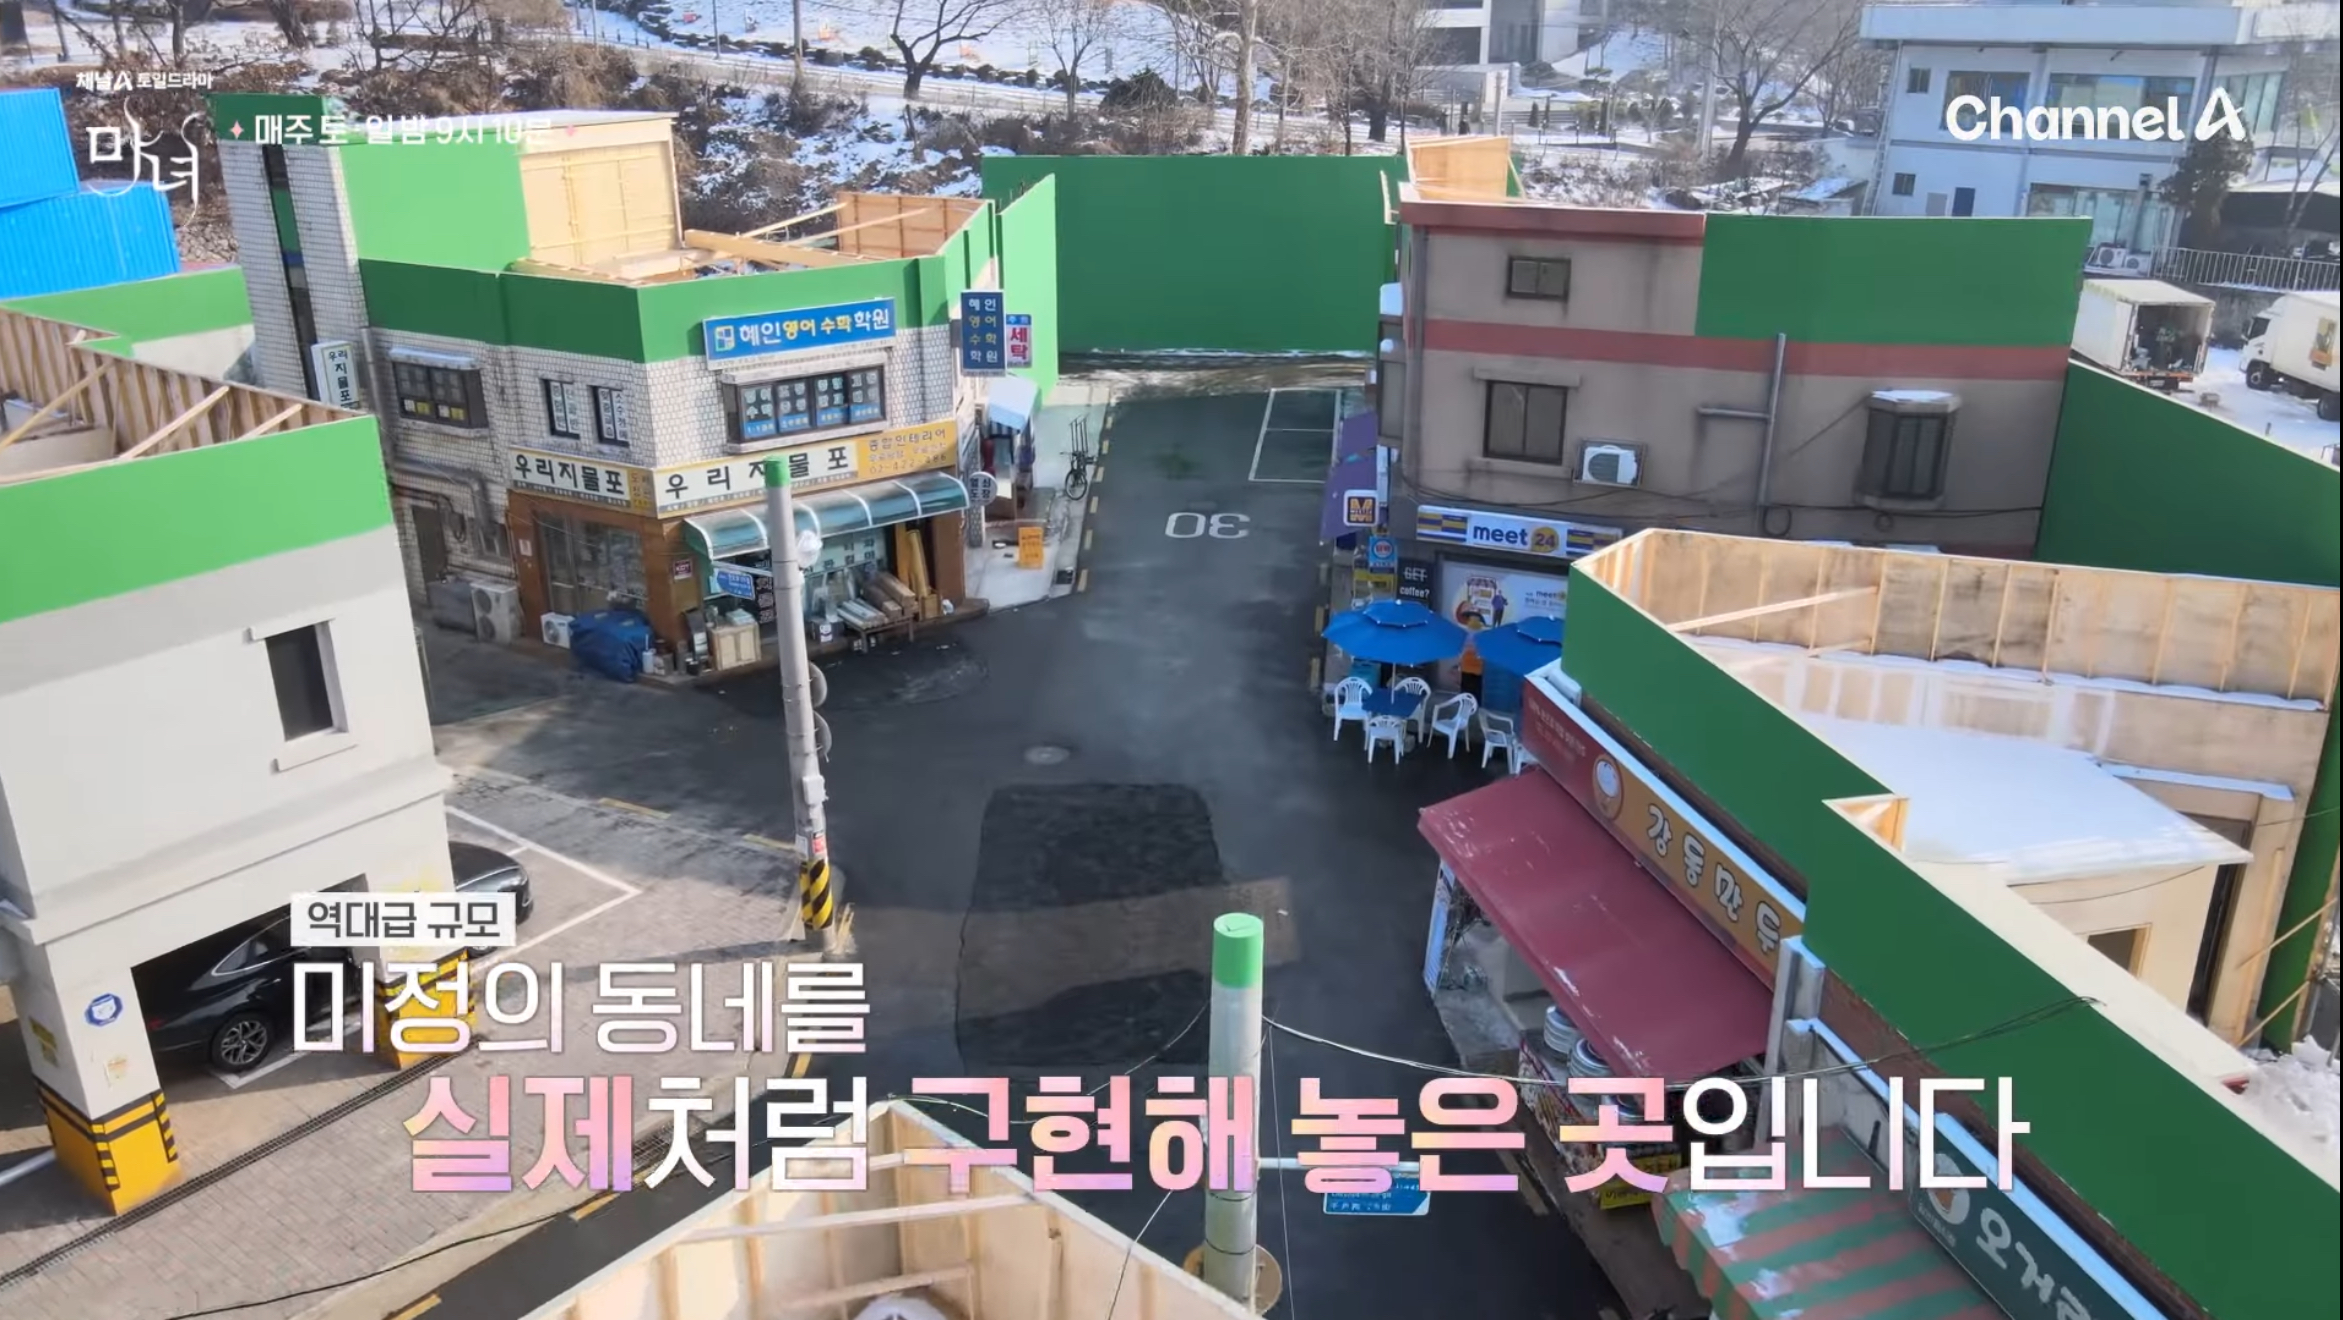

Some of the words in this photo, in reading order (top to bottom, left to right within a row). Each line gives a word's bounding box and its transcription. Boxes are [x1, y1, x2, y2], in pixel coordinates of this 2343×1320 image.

[969, 316, 997, 328] 영어
[1010, 327, 1028, 360] 세탁
[970, 350, 998, 363] 학원
[870, 429, 946, 452] 종합인테리어
[515, 454, 625, 496] 우리지물포
[1165, 512, 1251, 538] 30
[1473, 524, 1528, 546] meet
[1535, 533, 1556, 548] 24
[1400, 586, 1430, 598] coffee?
[1647, 803, 1781, 954] 강동만두
